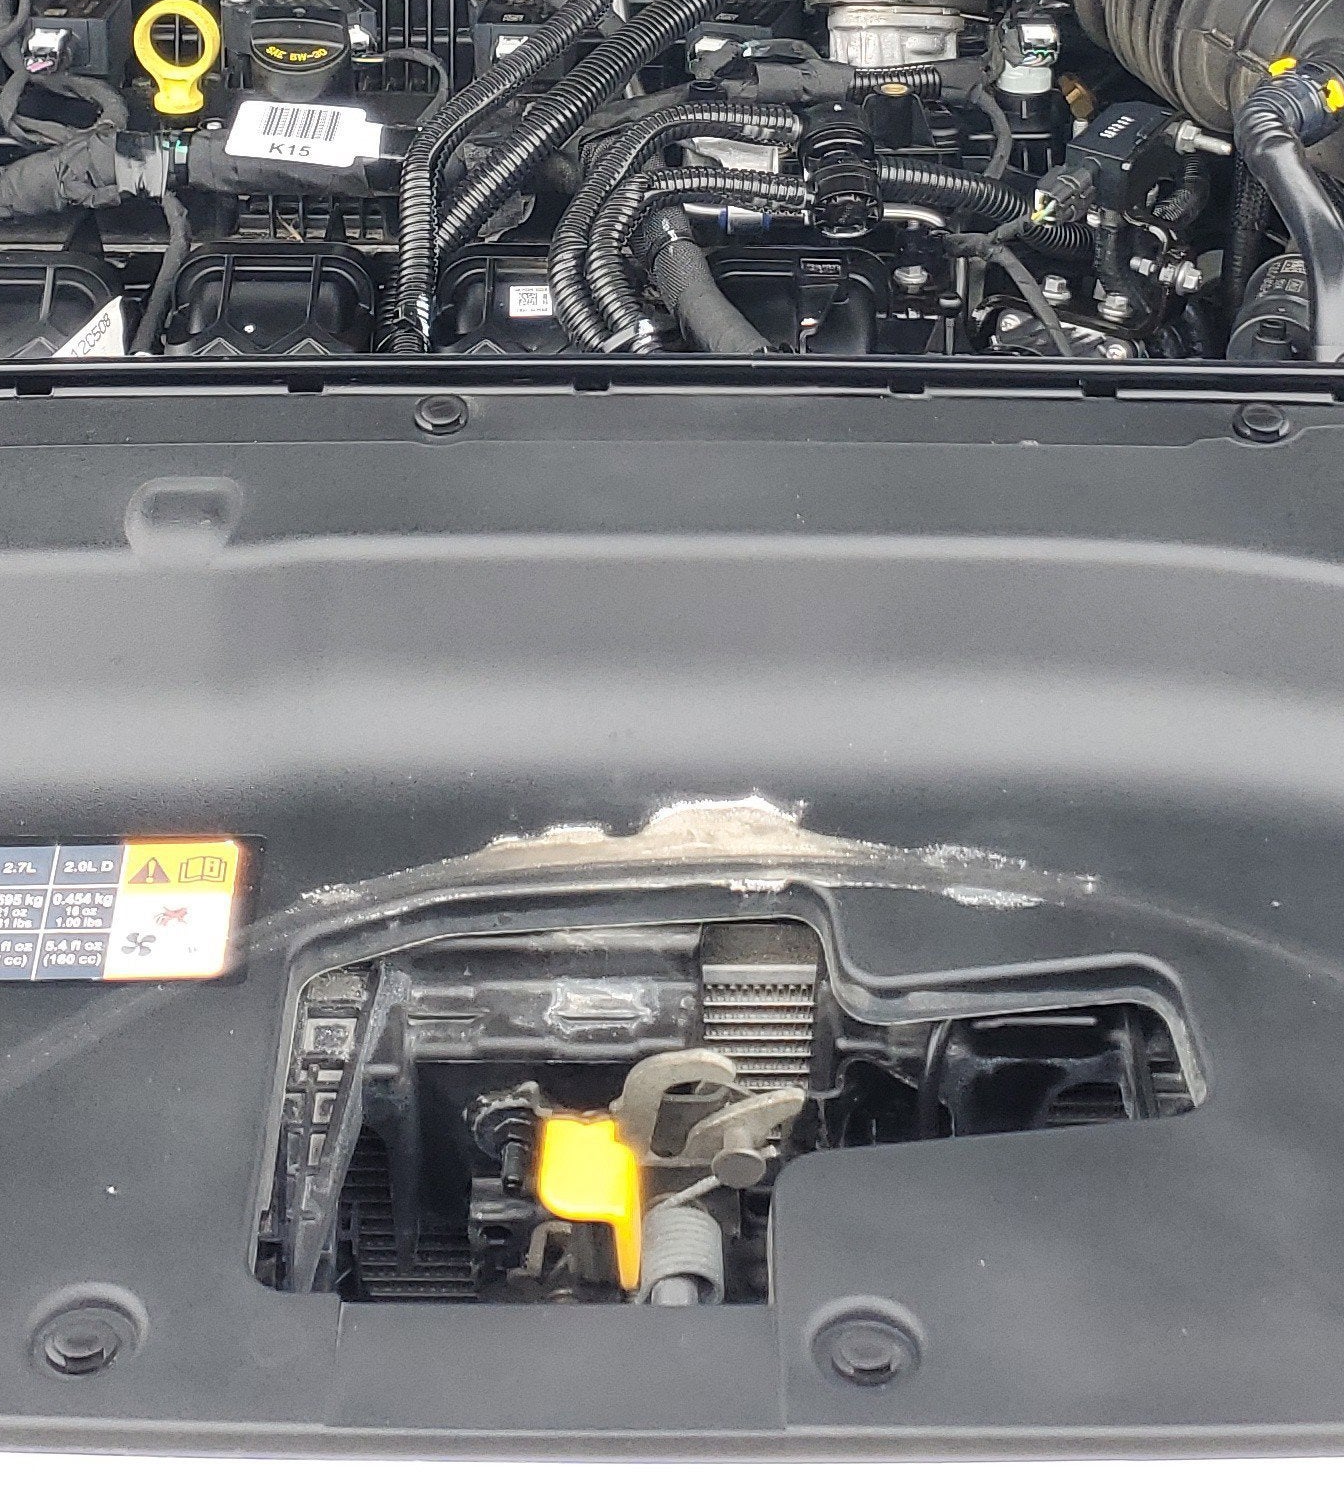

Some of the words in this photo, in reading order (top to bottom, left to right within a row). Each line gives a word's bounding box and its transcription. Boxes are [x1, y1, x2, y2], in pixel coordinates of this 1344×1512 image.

[269, 143, 311, 156] K15
[3, 862, 36, 874] 2.7L
[64, 861, 97, 872] 2.0L
[101, 861, 114, 871] D
[25, 894, 43, 908] kg
[52, 893, 91, 905] 0.454
[95, 893, 113, 907] kg
[12, 908, 28, 917] oz
[82, 908, 97, 916] oz
[13, 918, 32, 928] lbs
[56, 917, 81, 927] 1.00
[83, 917, 102, 927] lbs
[1, 941, 11, 951] fl
[15, 943, 33, 951] oz
[71, 940, 81, 951] fl
[85, 942, 103, 951] oz
[4, 954, 28, 967] cc)
[79, 954, 101, 966] cc)
